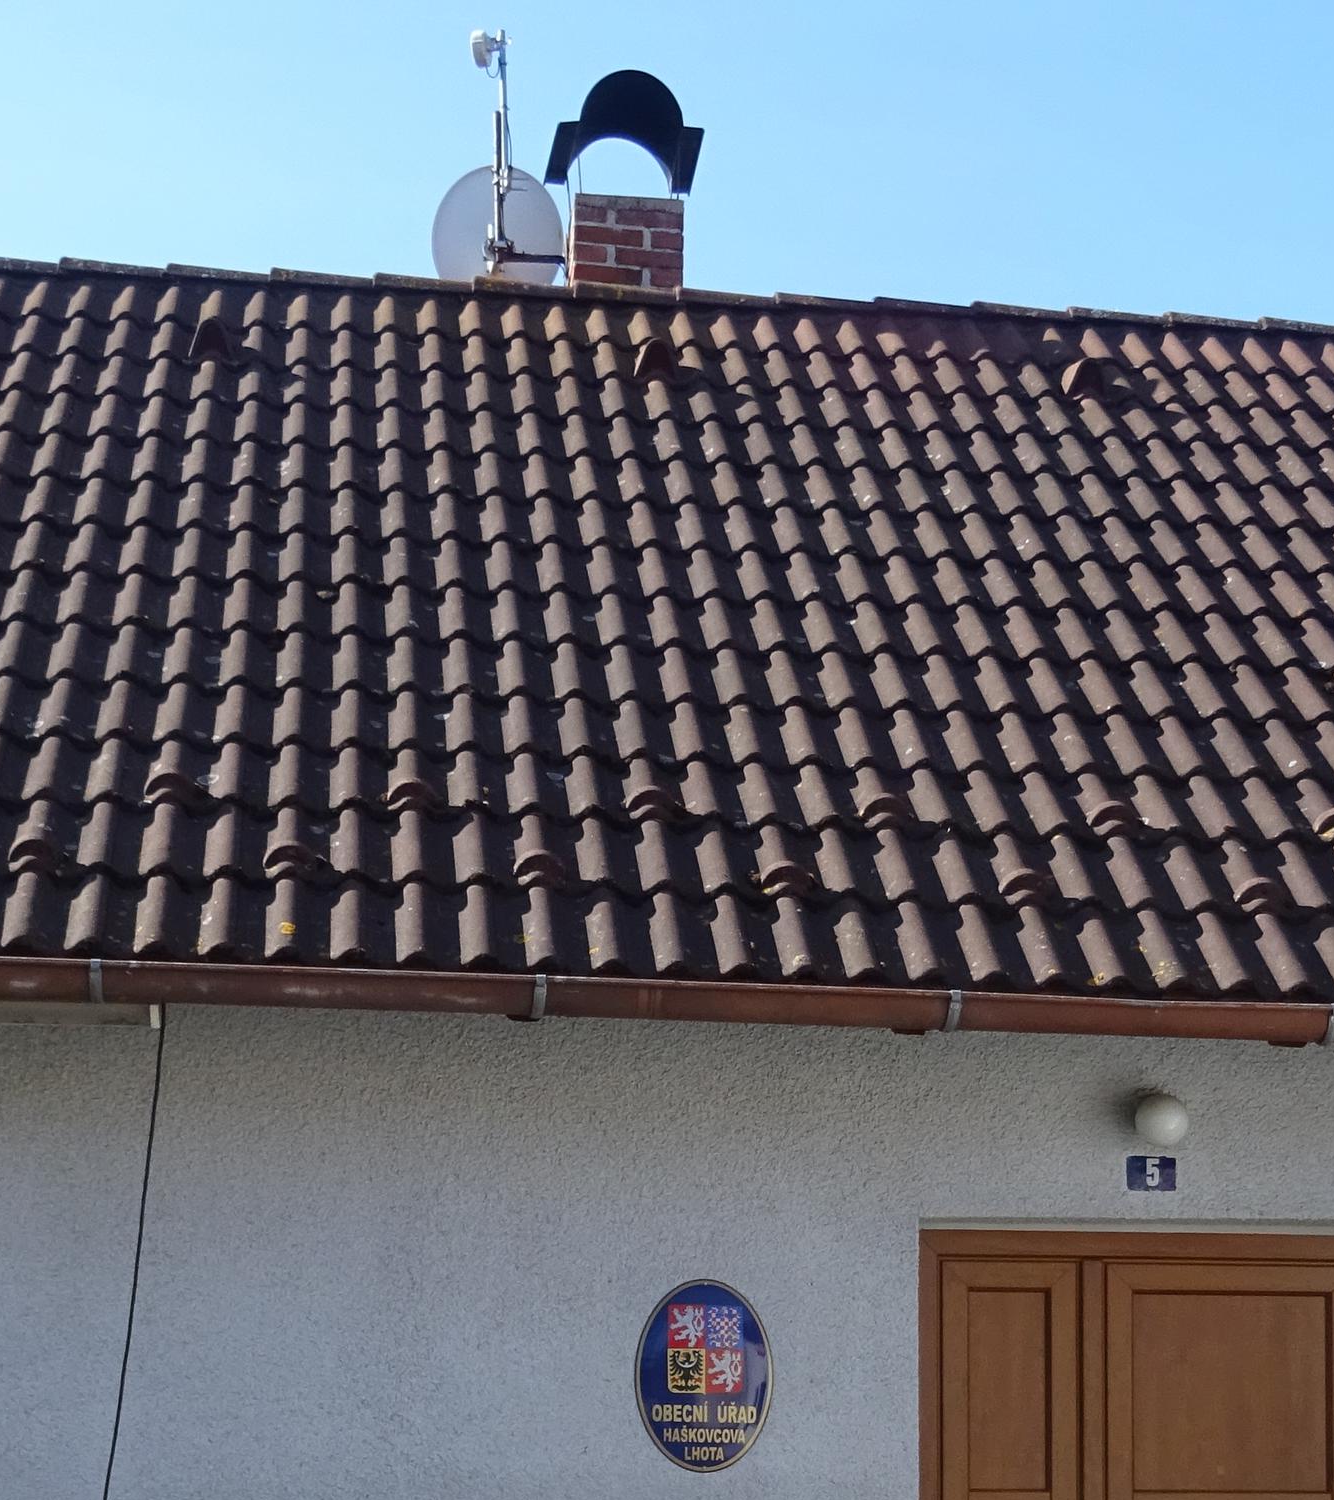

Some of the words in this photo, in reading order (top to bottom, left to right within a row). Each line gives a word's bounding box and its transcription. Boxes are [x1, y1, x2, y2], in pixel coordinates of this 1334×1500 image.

[1146, 1158, 1160, 1187] 5
[652, 1401, 707, 1423] OBECNÍ
[717, 1401, 757, 1424] ÚŘAD
[663, 1425, 746, 1444] HAŠKOVCOVA
[684, 1446, 724, 1461] LHOTA
